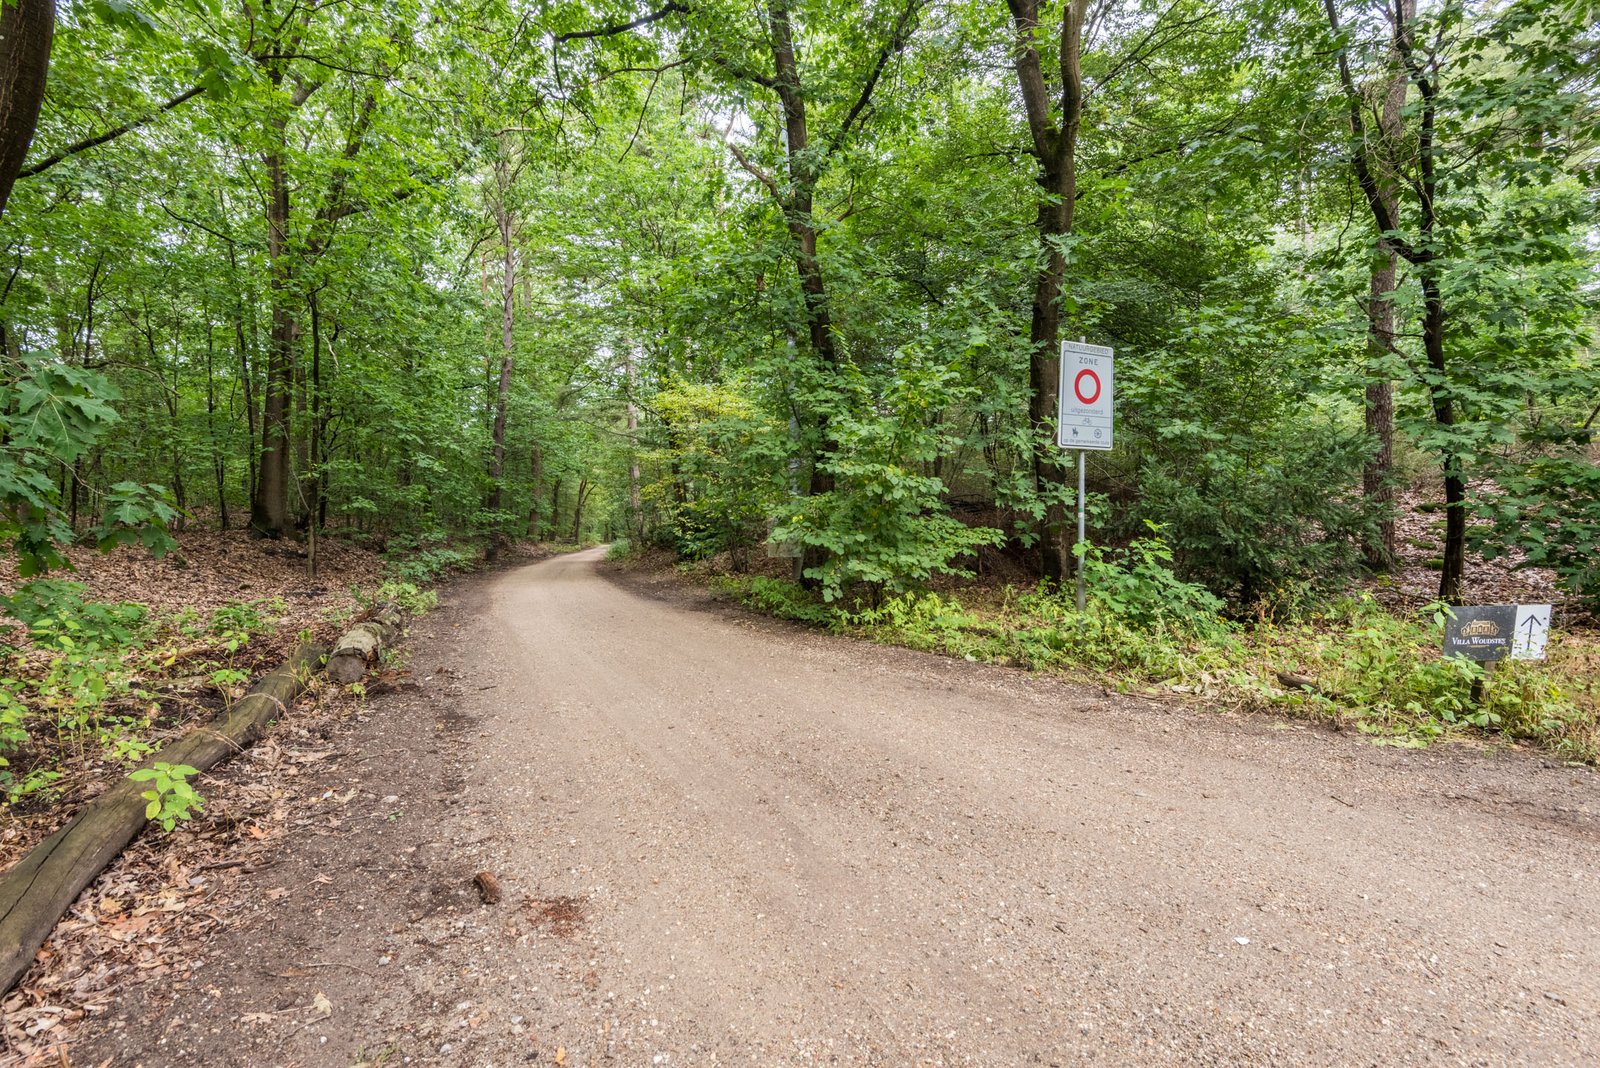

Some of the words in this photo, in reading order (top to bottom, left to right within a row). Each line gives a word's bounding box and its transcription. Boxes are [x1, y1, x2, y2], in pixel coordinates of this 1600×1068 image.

[1068, 343, 1109, 354] NATUURGEBIED
[1078, 356, 1099, 366] ZONE
[1070, 406, 1104, 416] uitgezonderd
[1452, 637, 1470, 645] VILLA
